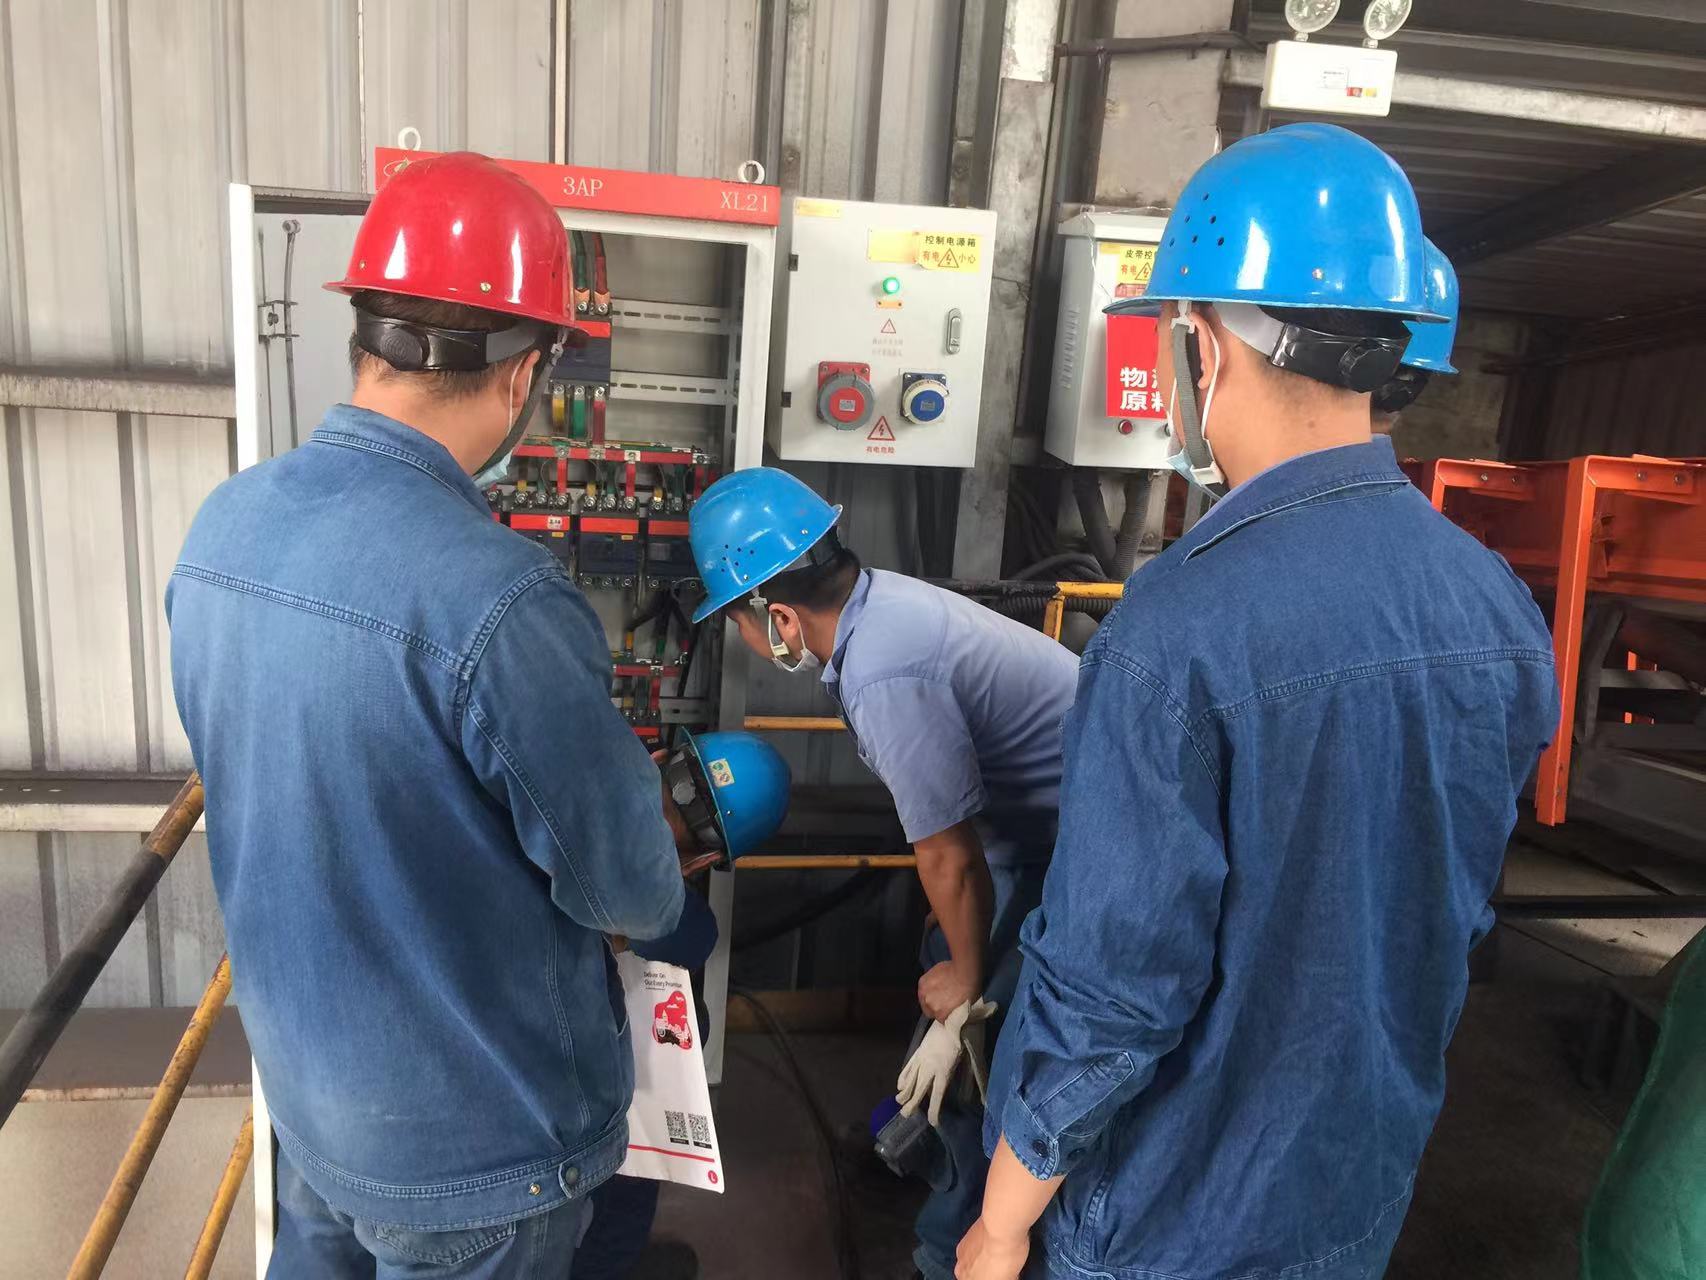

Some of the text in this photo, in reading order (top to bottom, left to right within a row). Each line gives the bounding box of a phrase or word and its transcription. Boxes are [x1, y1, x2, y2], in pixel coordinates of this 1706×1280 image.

[563, 176, 603, 197] 3AP
[721, 191, 769, 213] XL21
[925, 235, 976, 247] 控制电源箱
[922, 250, 976, 264] 有电 小心
[1121, 264, 1137, 276] 有电
[866, 446, 894, 454] 有电危险
